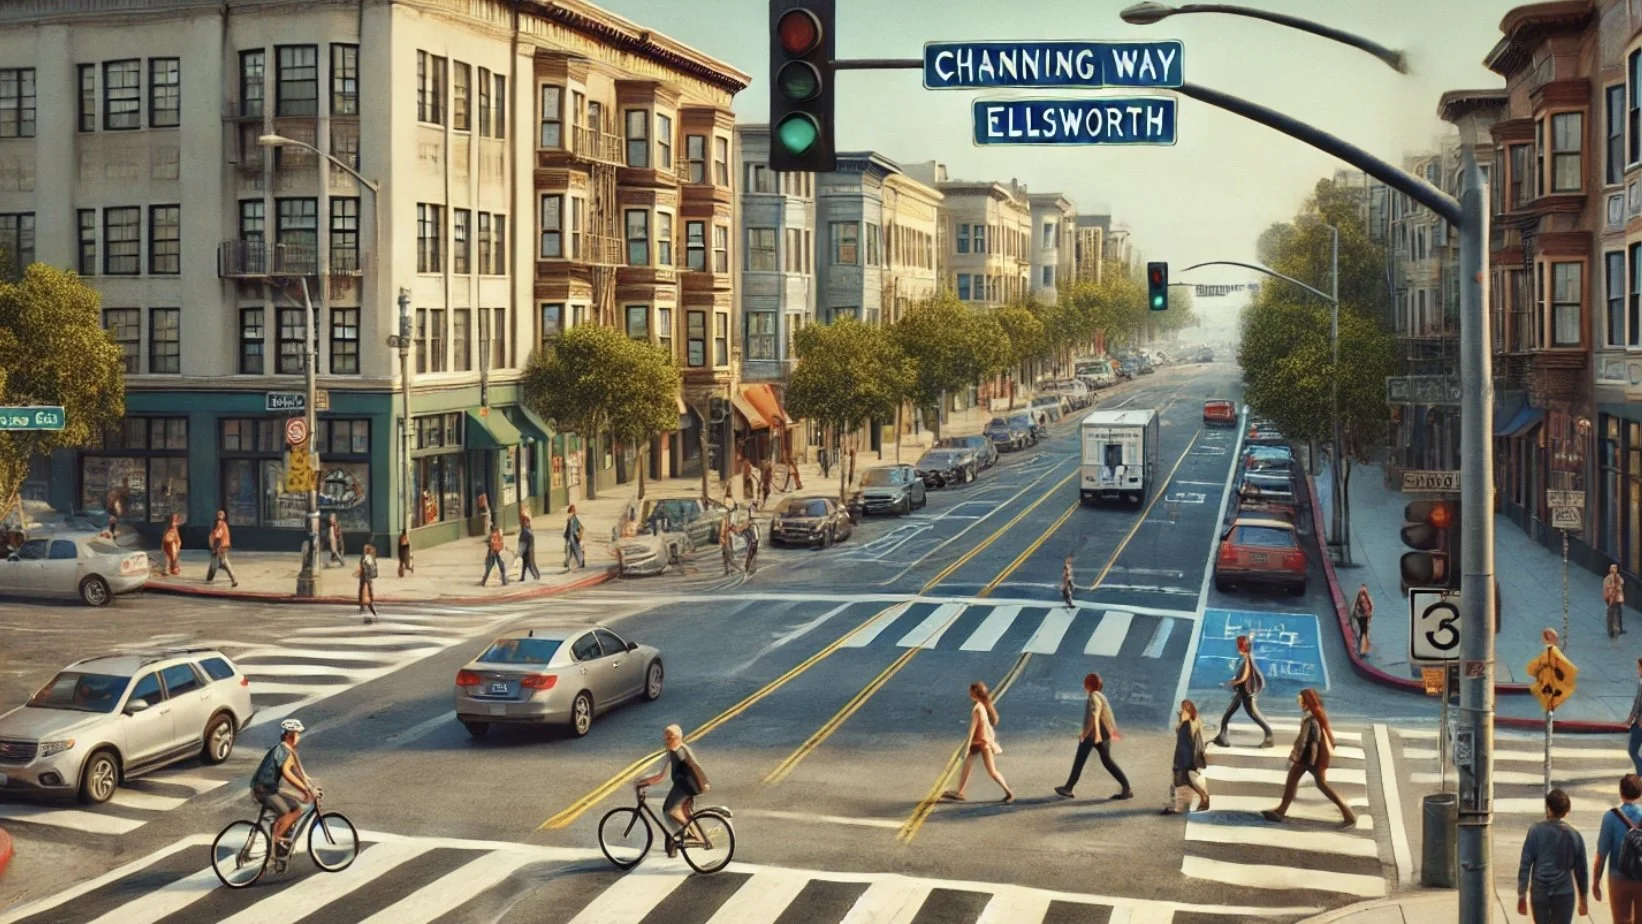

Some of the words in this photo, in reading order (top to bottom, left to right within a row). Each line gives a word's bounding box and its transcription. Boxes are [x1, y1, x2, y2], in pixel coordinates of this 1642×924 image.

[935, 48, 1094, 83] CHANNING
[1112, 48, 1176, 82] WAY
[986, 106, 1164, 137] ELLSWORTH
[1421, 602, 1460, 651] 3
